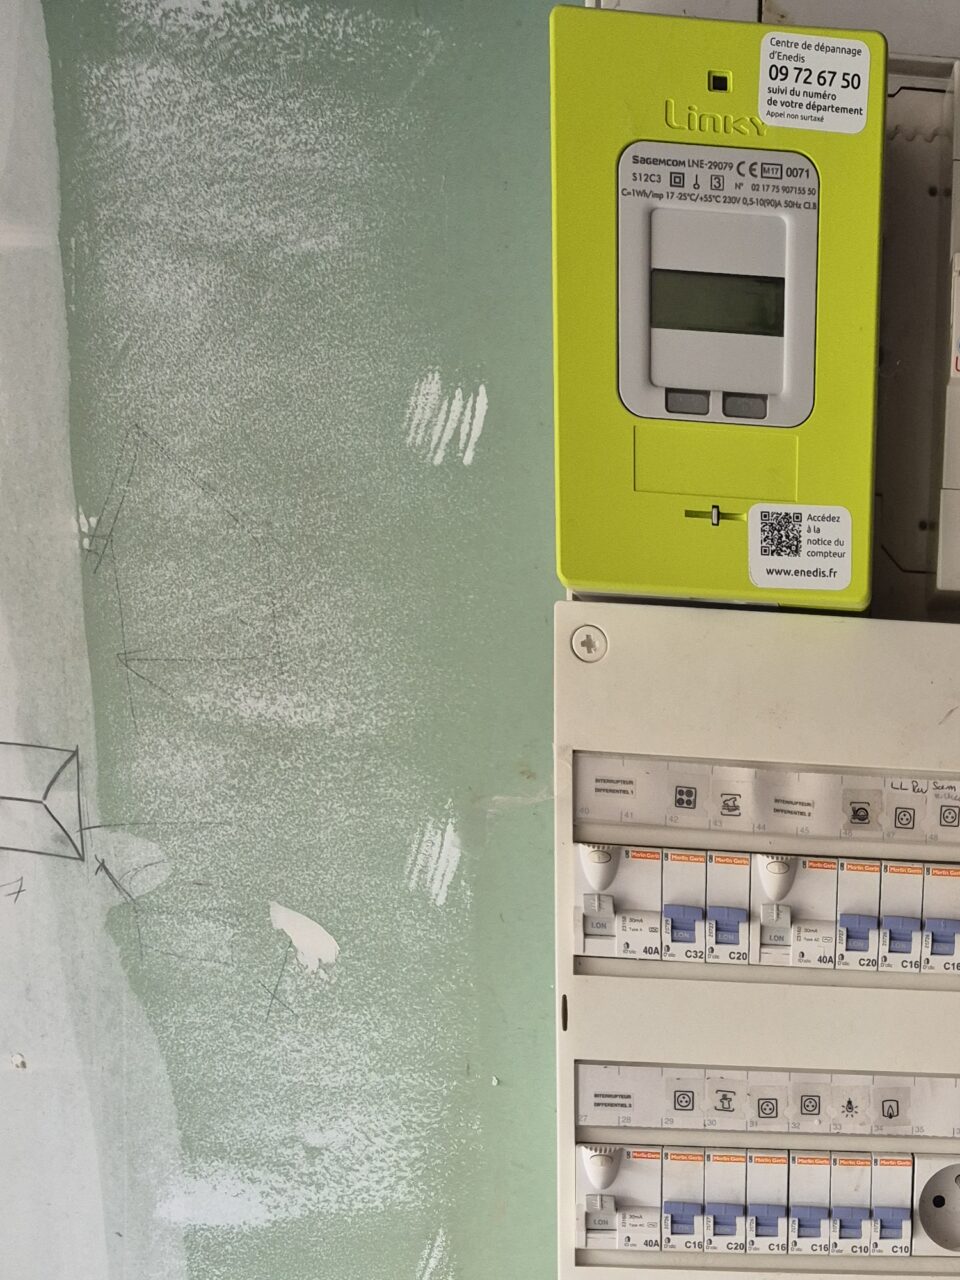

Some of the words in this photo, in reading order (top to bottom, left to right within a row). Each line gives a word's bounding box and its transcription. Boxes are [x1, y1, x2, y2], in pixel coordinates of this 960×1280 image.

[770, 37, 799, 49] Centre
[801, 40, 812, 50] de
[814, 42, 862, 57] dépannage
[769, 50, 805, 63] d'Enedis
[768, 64, 788, 81] 09
[793, 67, 812, 84] 72
[817, 70, 837, 87] 67
[841, 73, 861, 89] 50
[767, 86, 787, 95] suivi
[790, 87, 800, 97] du
[803, 89, 837, 100] numéro
[767, 97, 778, 106] de
[780, 100, 804, 109] votre
[805, 101, 863, 115] département
[766, 110, 785, 118] Appel
[800, 114, 824, 122] surtaxé
[688, 159, 734, 171] LNE-29079
[763, 167, 779, 175] M17
[786, 167, 810, 179] 0071
[632, 172, 662, 183] S12C3
[751, 183, 760, 191] 02
[762, 184, 770, 192] 17
[772, 185, 780, 193] 75
[808, 188, 816, 196] 50
[806, 513, 840, 522] Accédez
[806, 525, 811, 533] à
[814, 526, 820, 534] la
[806, 538, 832, 546] notice
[834, 538, 844, 546] du
[806, 550, 846, 559] compteur
[766, 567, 837, 578] www.enedis.fr
[643, 946, 660, 955] 40A
[685, 950, 704, 959] C32
[729, 952, 748, 960] C20
[817, 955, 834, 964] 40A
[858, 958, 877, 967] C20
[901, 960, 920, 969] C16
[791, 1121, 801, 1129] 32
[643, 1240, 660, 1248] 40A
[685, 1241, 703, 1249] C16
[726, 1242, 744, 1251] C20
[768, 1243, 786, 1251] C16
[811, 1244, 829, 1252] C16
[851, 1246, 869, 1254] C10
[891, 1246, 909, 1254] C10
